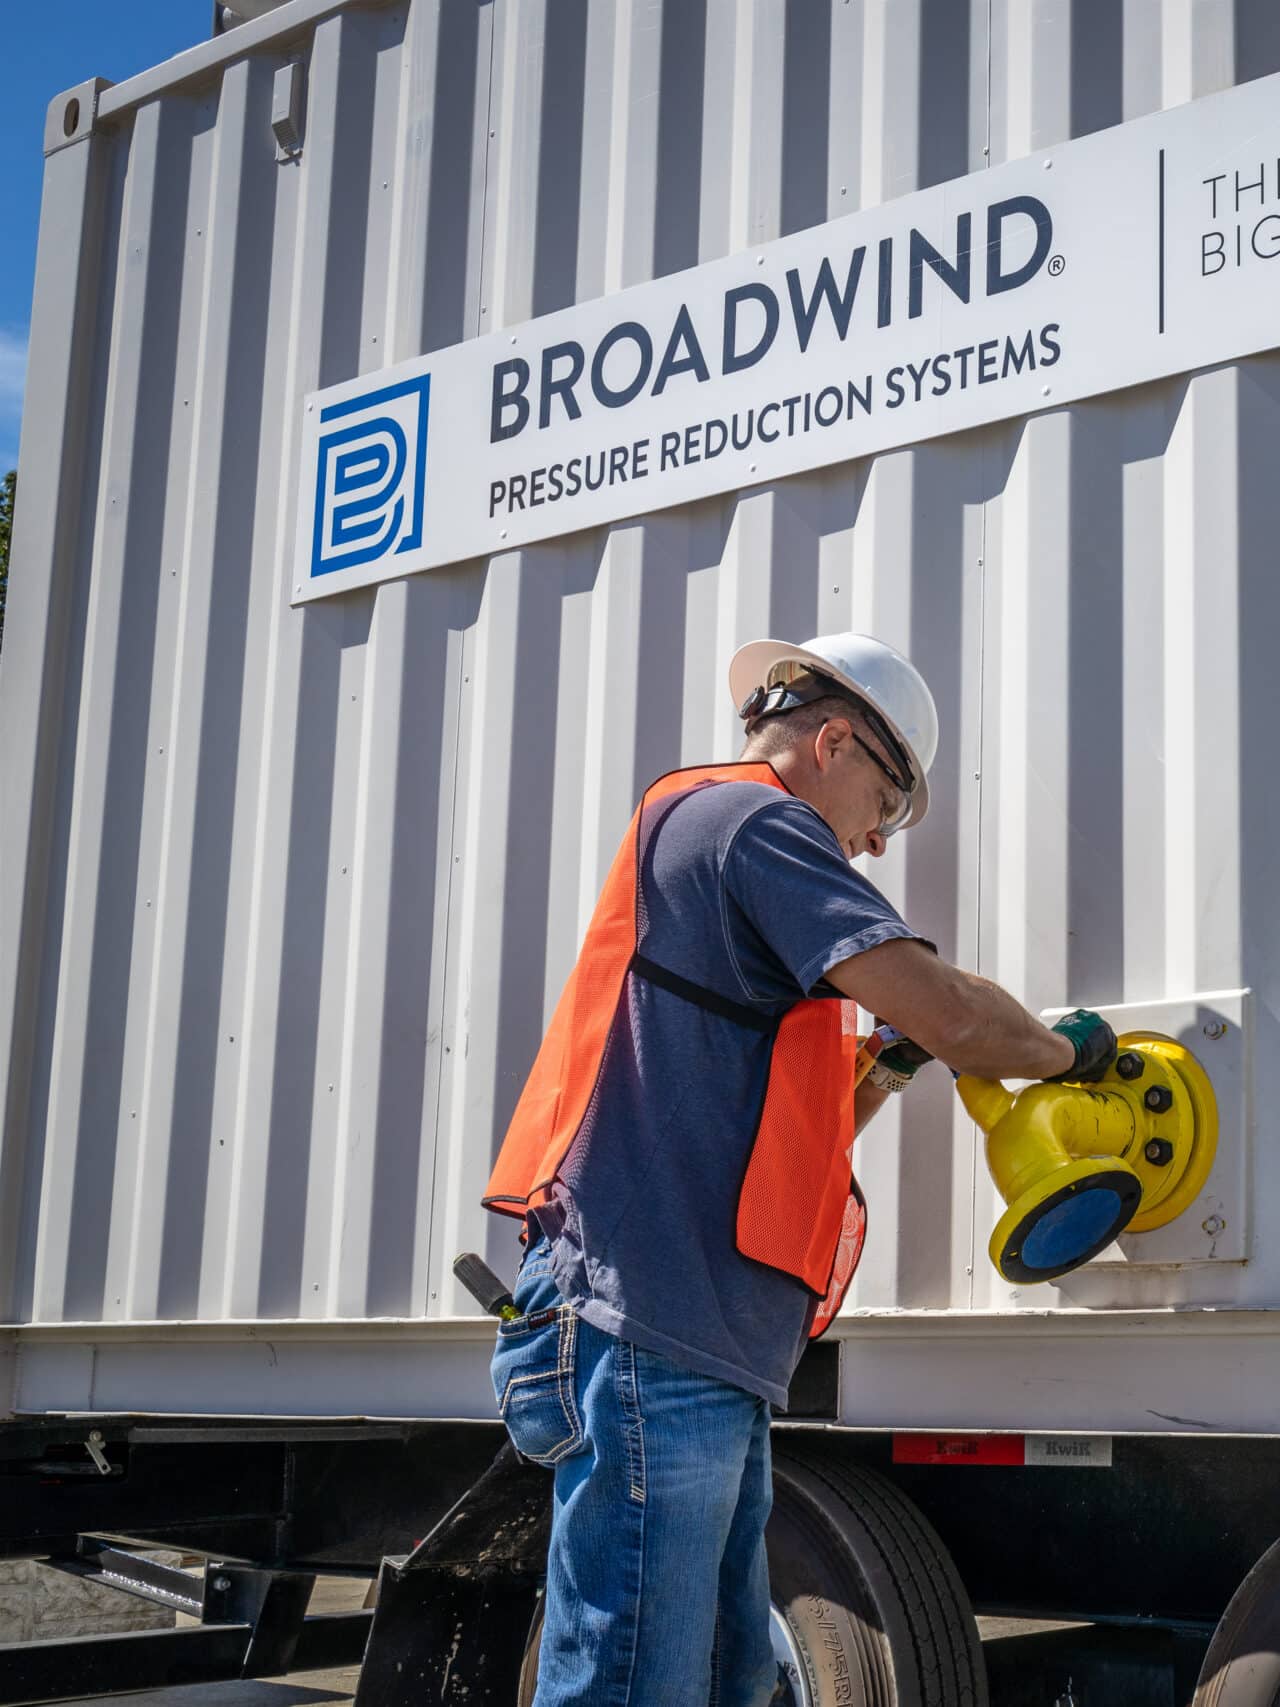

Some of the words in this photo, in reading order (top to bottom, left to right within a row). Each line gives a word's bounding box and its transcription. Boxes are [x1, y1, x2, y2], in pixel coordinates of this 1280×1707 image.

[488, 438, 650, 518] PRESSURE
[660, 374, 873, 469] REDUCTION
[884, 323, 1062, 409] SYSTEMS
[1045, 1441, 1091, 1457] KwiK
